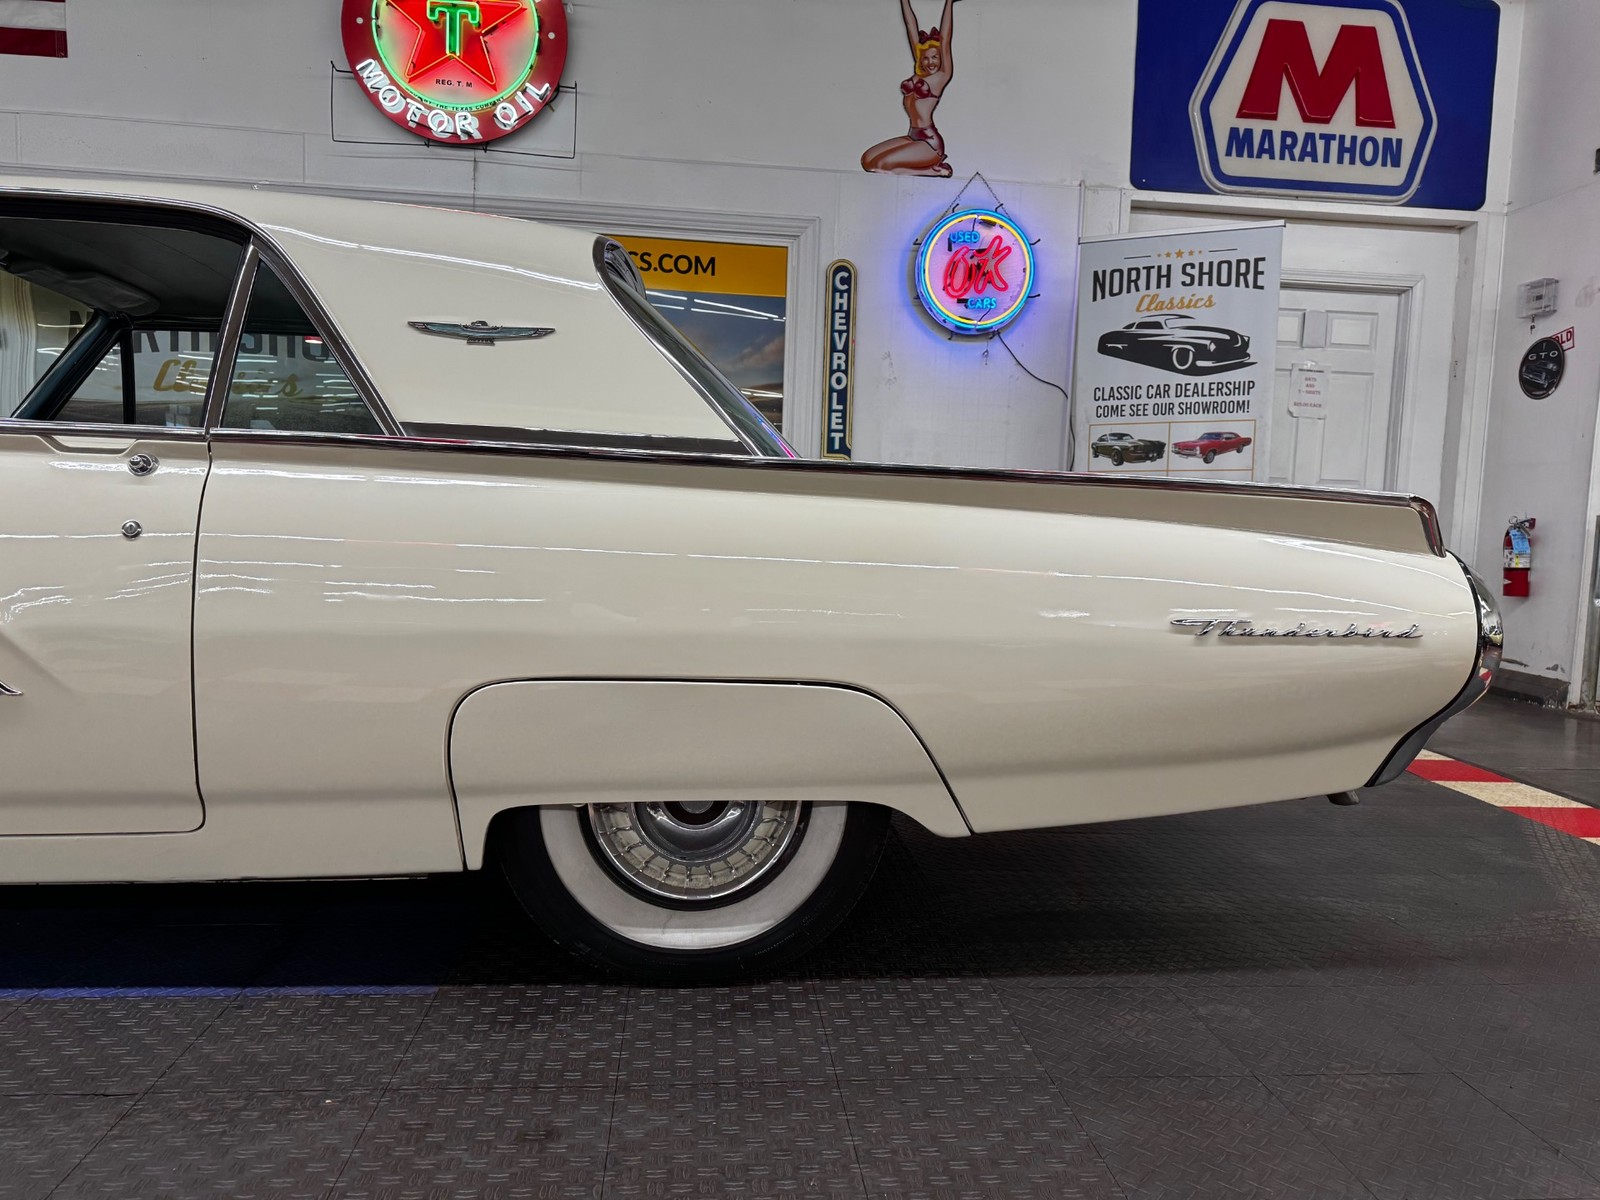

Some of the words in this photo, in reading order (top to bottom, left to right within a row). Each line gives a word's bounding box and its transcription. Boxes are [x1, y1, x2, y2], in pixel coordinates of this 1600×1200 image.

[427, 0, 480, 56] T
[1236, 18, 1396, 129] M
[356, 58, 483, 141] MOTOR
[494, 82, 550, 130] OIL
[1225, 126, 1403, 168] MARATHON
[950, 231, 980, 243] USED
[1092, 263, 1171, 302] NORTH
[1181, 257, 1266, 290] SHORE
[967, 298, 997, 309] CARS
[1136, 292, 1216, 313] Classics
[1554, 330, 1573, 345] OLD
[830, 271, 850, 450] CHEVROLET
[1528, 350, 1558, 360] GTO
[1093, 385, 1142, 402] CLASSIC
[1146, 383, 1171, 400] CAR
[1175, 380, 1256, 398] DEALERSHIP
[1096, 404, 1126, 418] COME
[1129, 403, 1149, 417] SEE
[1152, 402, 1175, 416] OUR
[1177, 400, 1250, 415] SHOWROOM!
[1170, 618, 1424, 639] Thunderbird
